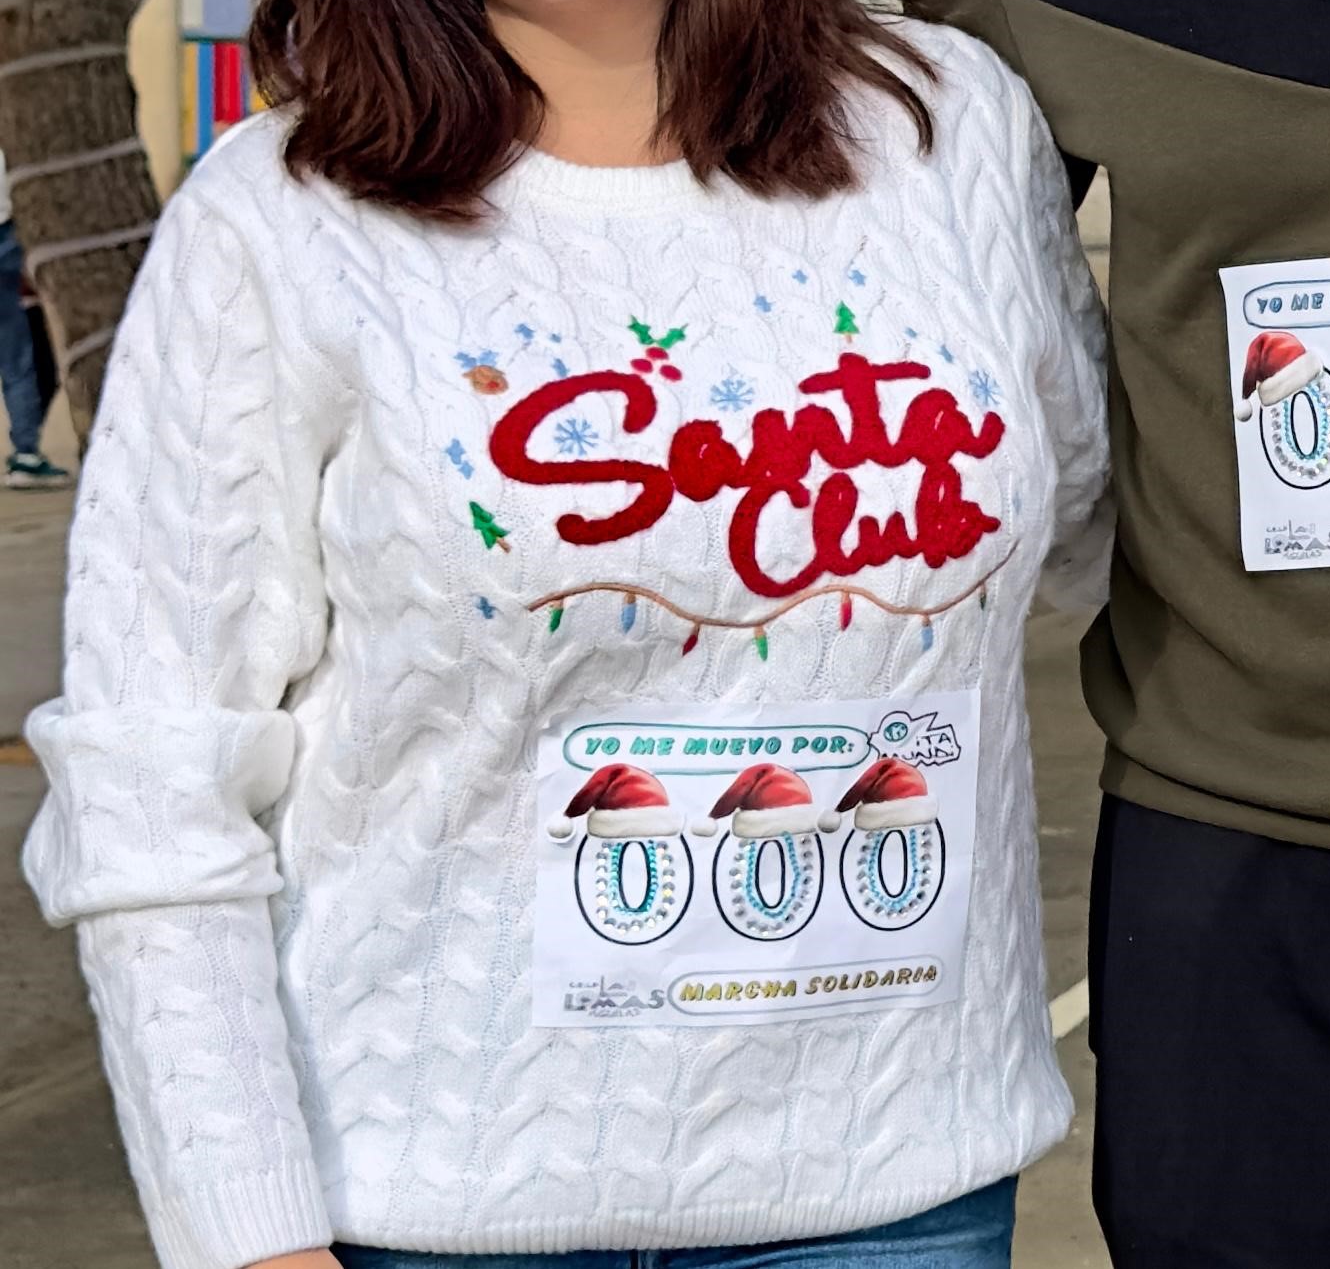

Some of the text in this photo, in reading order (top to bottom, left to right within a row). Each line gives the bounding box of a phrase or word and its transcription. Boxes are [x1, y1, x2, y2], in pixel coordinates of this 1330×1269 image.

[1256, 298, 1282, 314] YO
[1291, 292, 1324, 311] ME
[490, 352, 1006, 545] Santa
[729, 463, 1001, 598] Club
[585, 735, 855, 756] YO ME MUEVO POR:
[679, 965, 938, 1002] MARCHA SOLIDARIA
